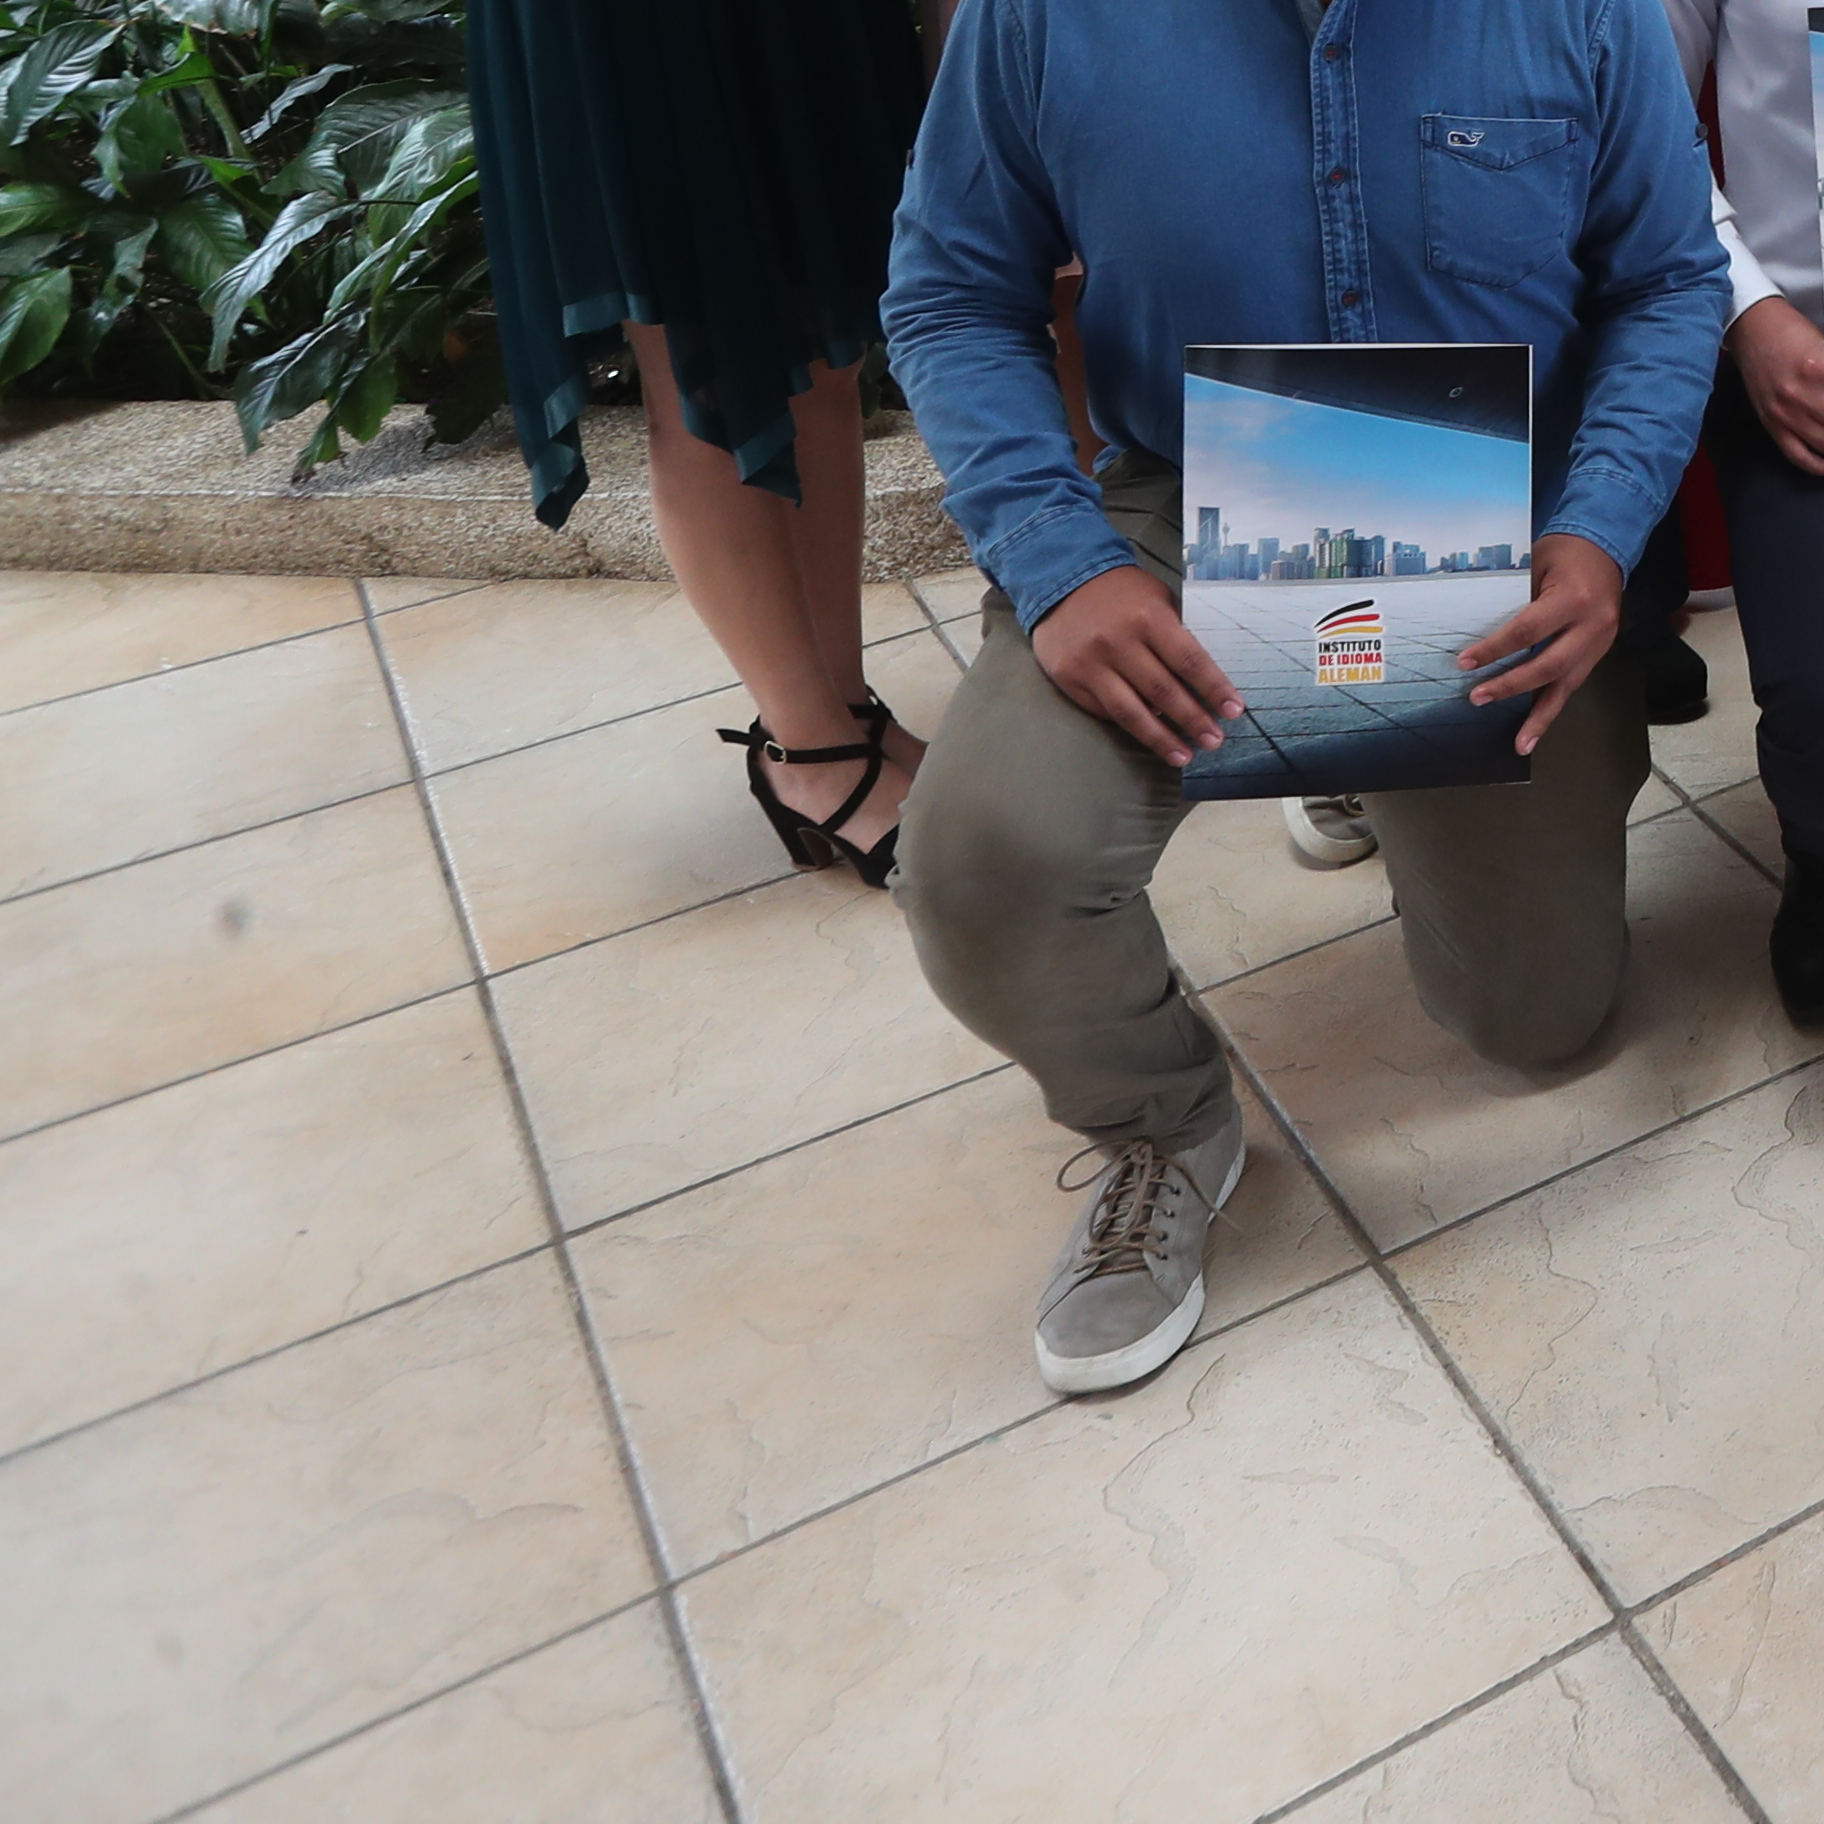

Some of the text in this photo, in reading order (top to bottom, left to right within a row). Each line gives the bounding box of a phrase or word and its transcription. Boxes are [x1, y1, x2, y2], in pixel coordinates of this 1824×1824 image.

[1318, 639, 1381, 653] INSTITUTO
[1319, 653, 1382, 666] DE IDIOMA
